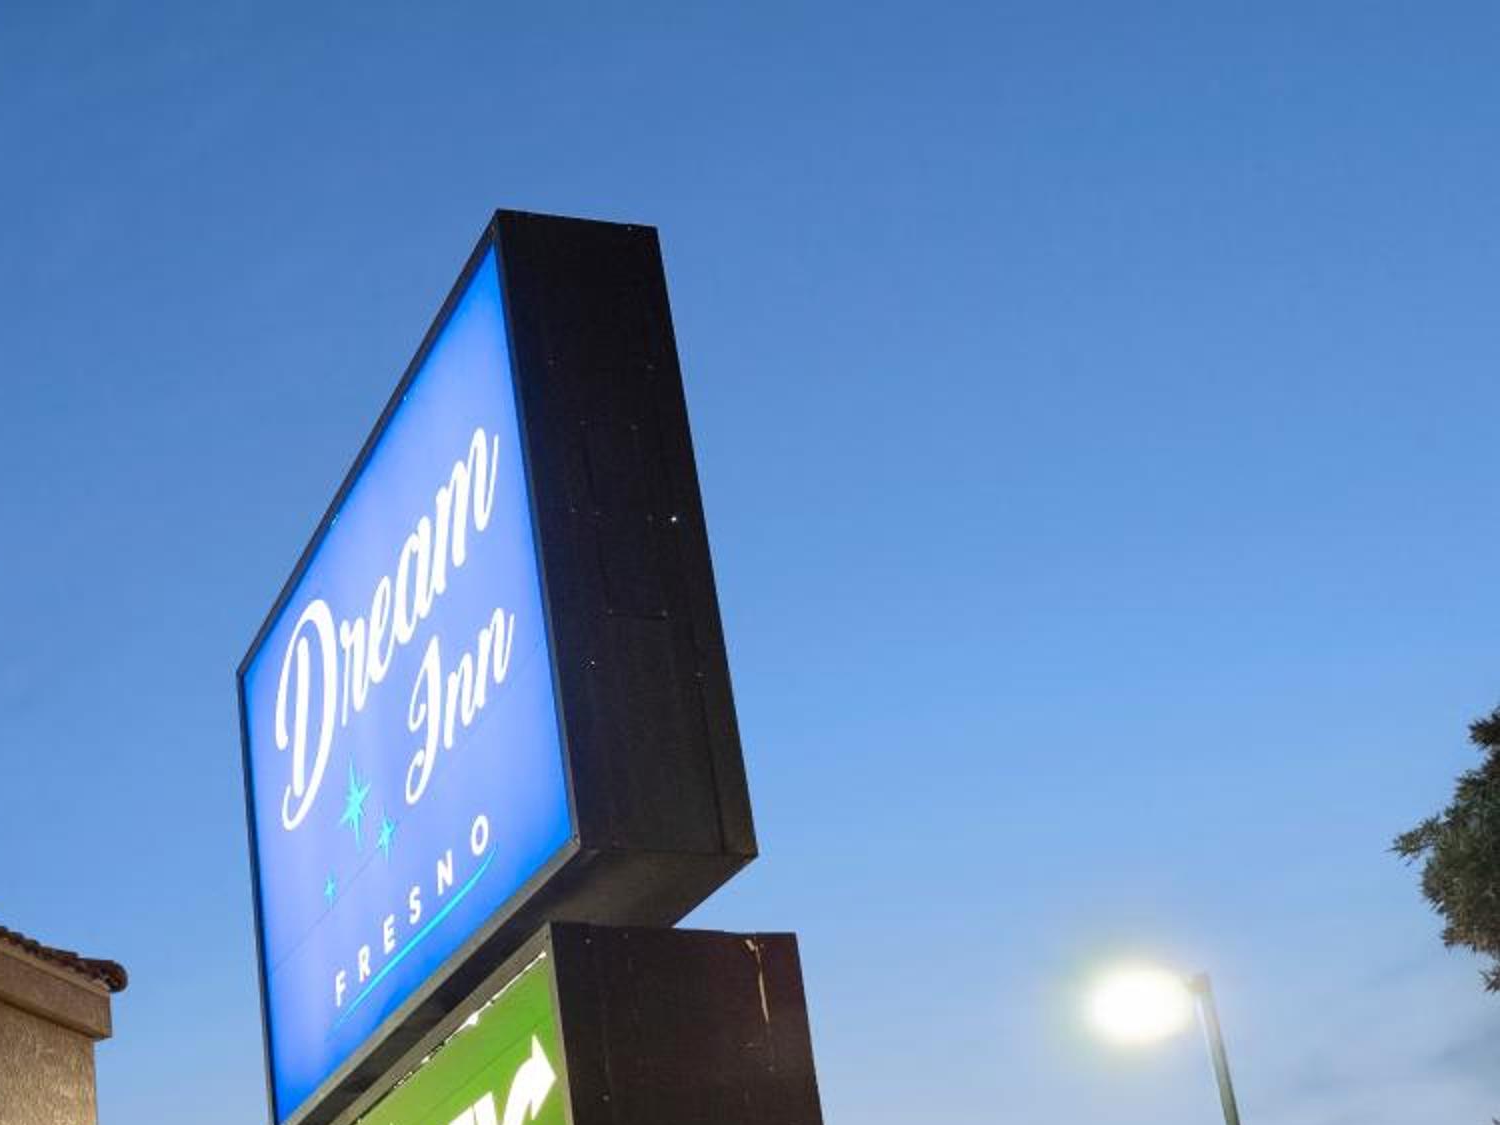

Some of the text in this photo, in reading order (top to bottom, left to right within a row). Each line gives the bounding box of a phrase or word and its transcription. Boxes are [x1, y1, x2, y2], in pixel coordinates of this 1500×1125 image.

[275, 427, 499, 830] Dream
[406, 607, 515, 804] Inn
[335, 815, 489, 1008] FRESNO
